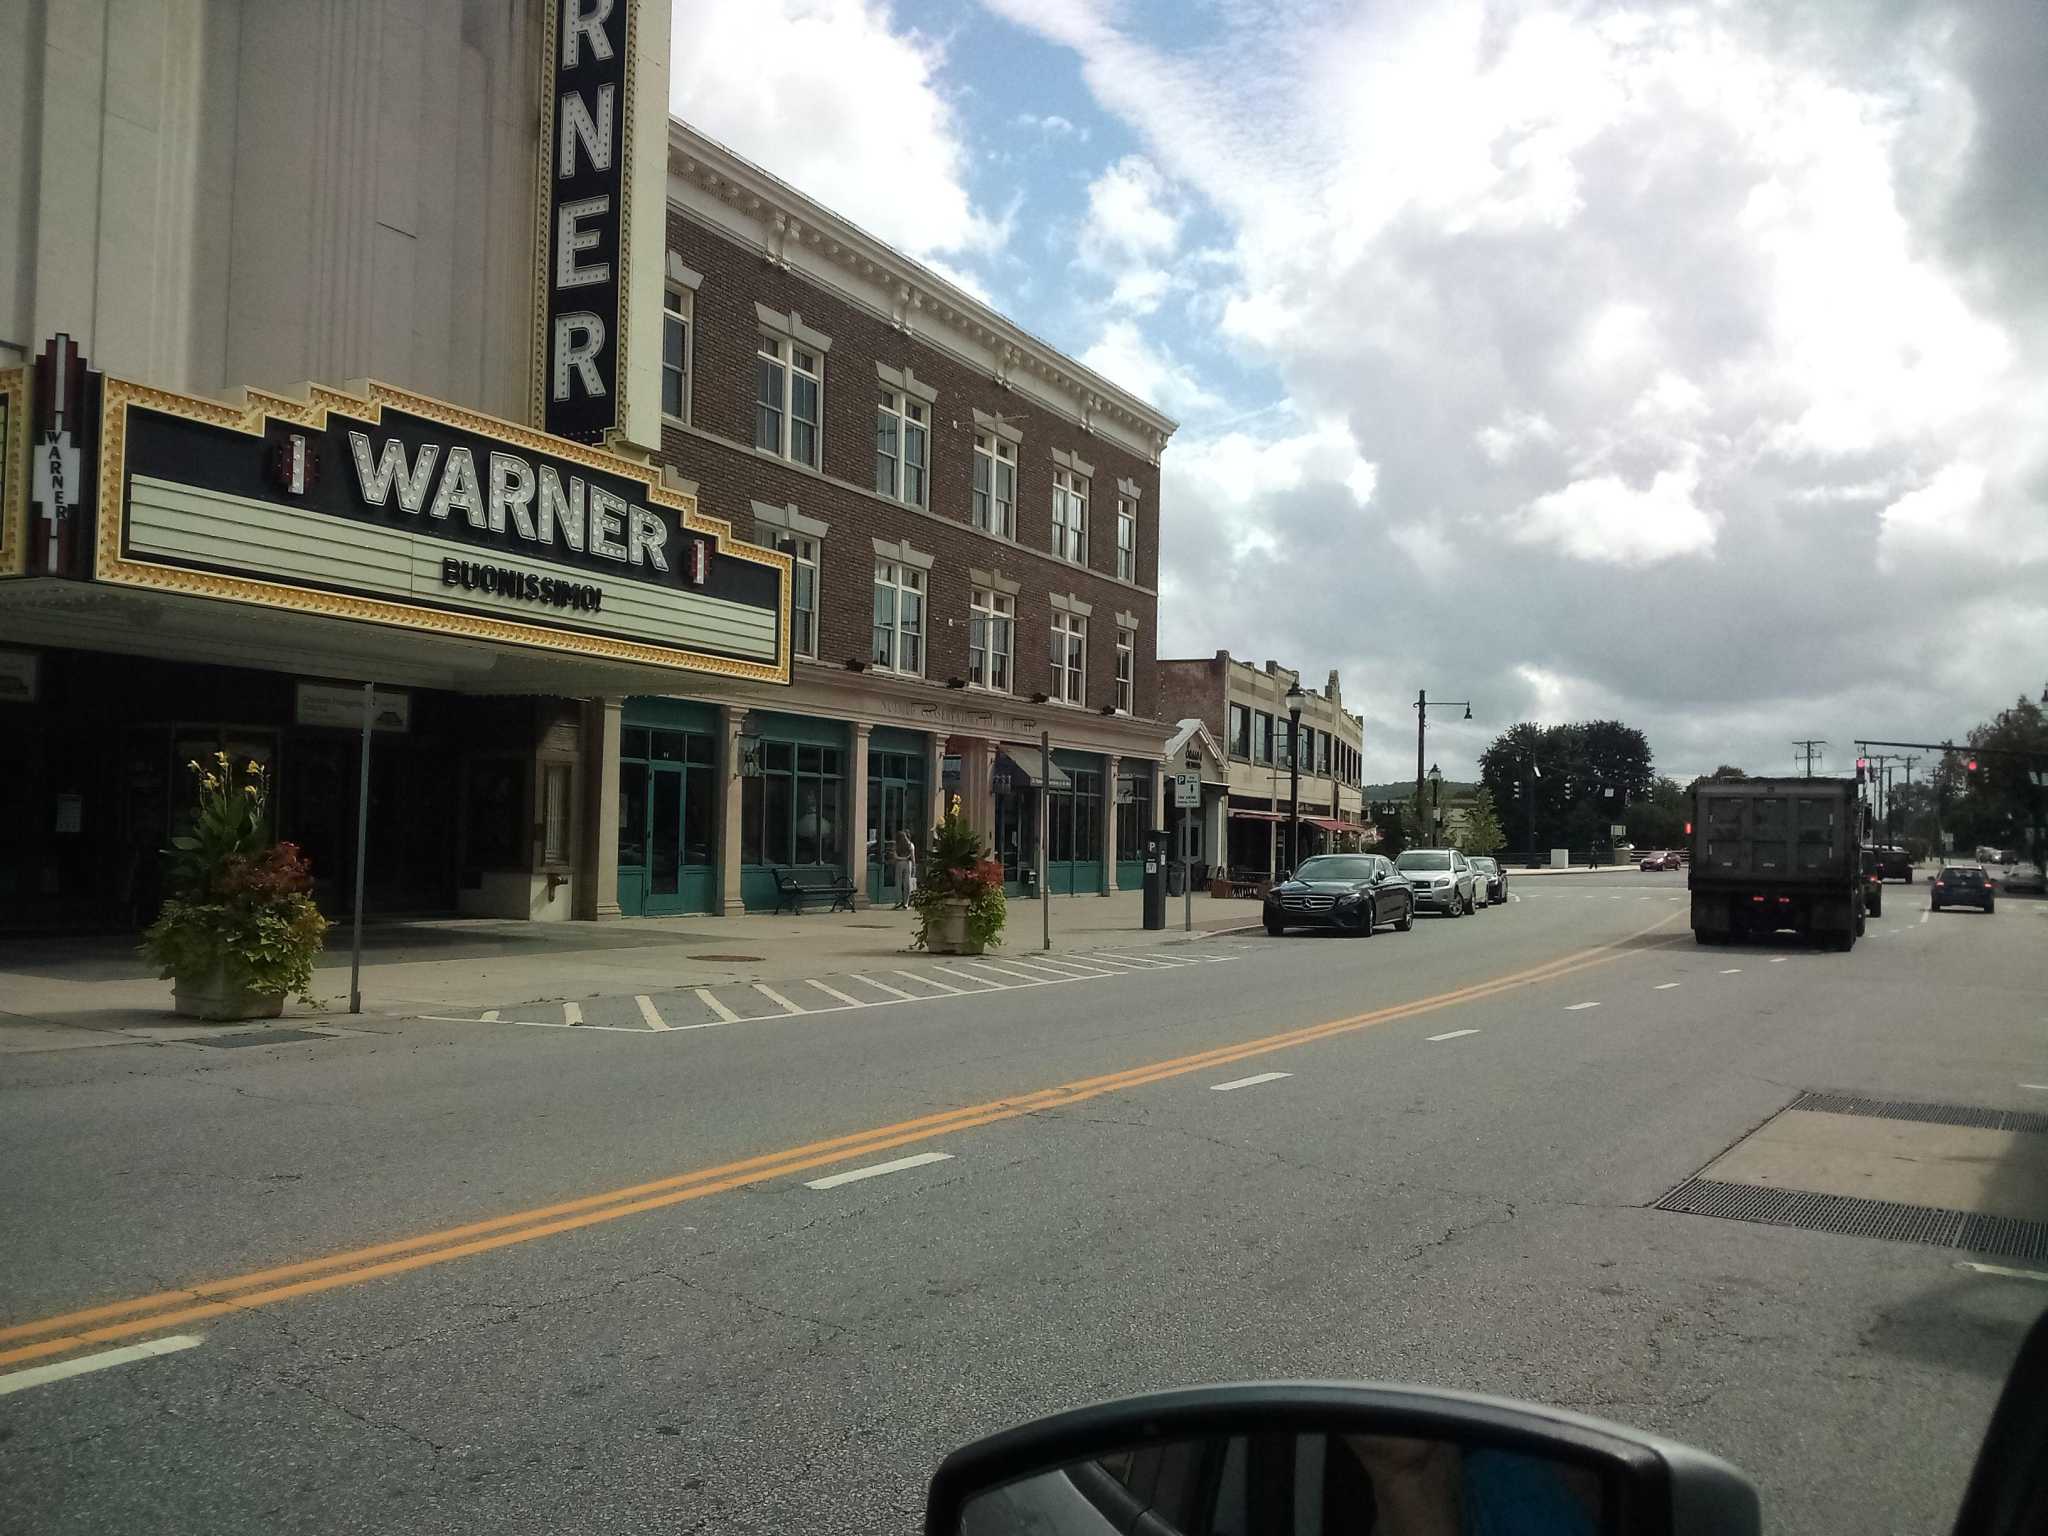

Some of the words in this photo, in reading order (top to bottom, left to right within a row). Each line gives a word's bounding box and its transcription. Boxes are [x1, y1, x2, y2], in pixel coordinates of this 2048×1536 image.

[46, 431, 69, 519] WARNER
[348, 430, 669, 572] WARNER
[442, 557, 603, 613] BUONISSIMO!
